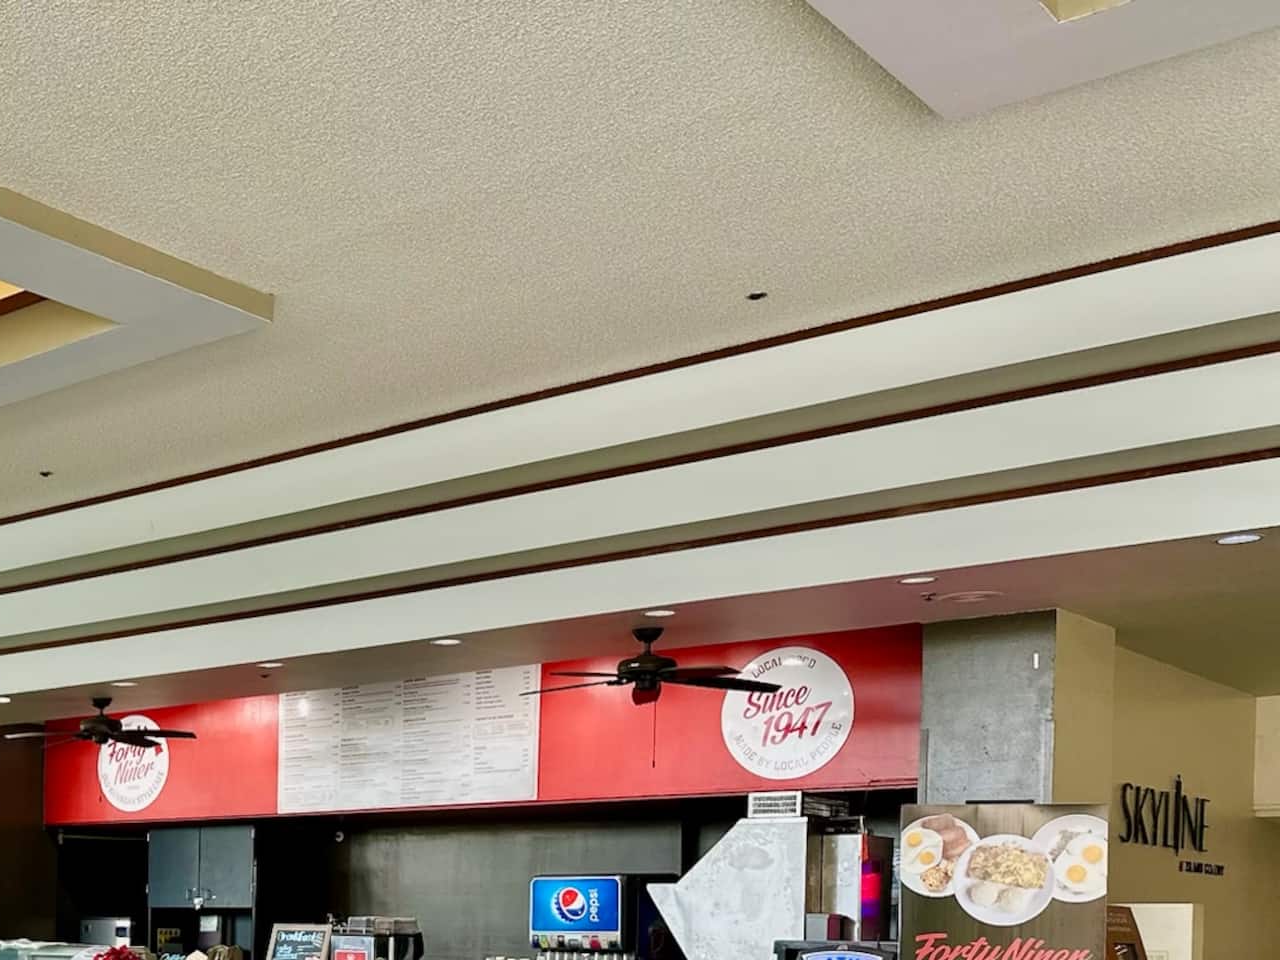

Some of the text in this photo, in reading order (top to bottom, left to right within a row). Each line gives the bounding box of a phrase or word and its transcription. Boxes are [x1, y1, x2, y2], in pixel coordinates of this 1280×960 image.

[743, 685, 813, 720] Since
[761, 700, 833, 748] 1947
[773, 756, 809, 771] LOCAL
[1118, 774, 1211, 857] SKYLINE
[588, 888, 601, 923] pepsi
